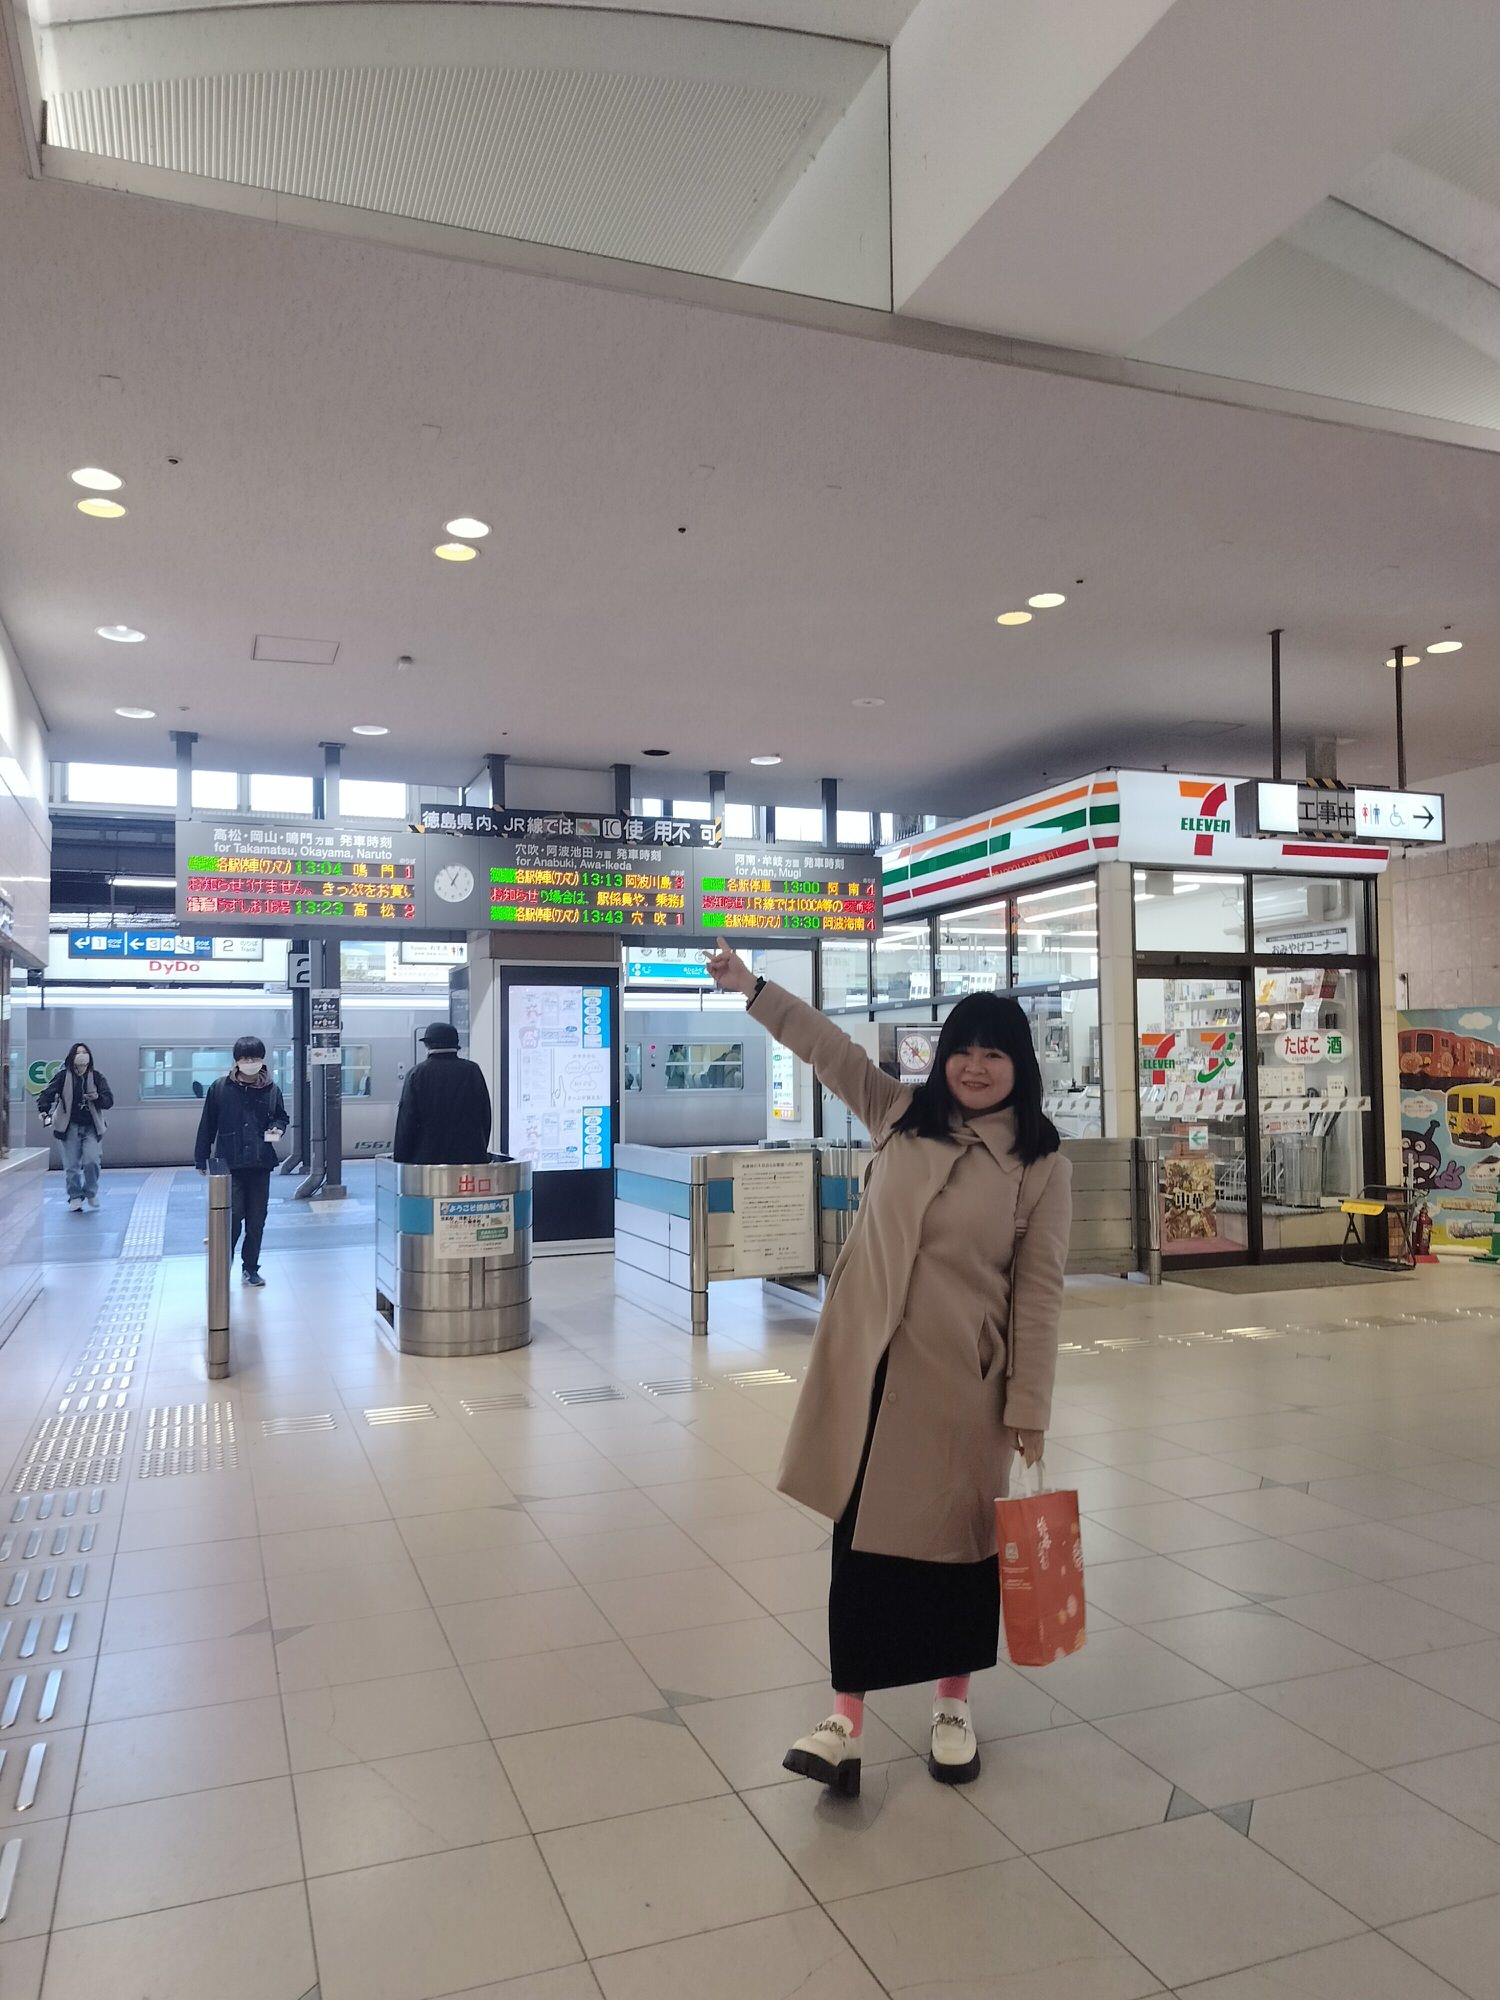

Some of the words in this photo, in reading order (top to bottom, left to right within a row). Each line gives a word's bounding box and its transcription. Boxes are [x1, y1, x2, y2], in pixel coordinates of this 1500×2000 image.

[1298, 799, 1356, 826] 工事中
[340, 834, 392, 849] 発車時刻
[214, 842, 232, 853] for
[233, 843, 298, 857] Takamatsu,
[300, 848, 354, 860] Okayama,
[356, 849, 392, 860] Naruto
[616, 848, 662, 862] 発車時刻
[295, 860, 343, 876] 13:04
[405, 865, 413, 879] 1
[516, 856, 532, 867] for
[533, 857, 578, 871] Anabuki,
[579, 860, 632, 871] Awa-Ikeda
[804, 856, 845, 870] 発車時刻
[735, 867, 749, 876] for
[750, 868, 777, 878] Anan,
[778, 869, 802, 879] Mugi
[582, 873, 623, 888] 13:13
[625, 874, 672, 890] 阿波川島
[727, 878, 772, 893] 各駅停車
[783, 881, 820, 895] 13:00
[866, 884, 876, 896] 4
[490, 888, 539, 904] お知らせ
[702, 895, 745, 911] お知らせ
[295, 901, 344, 916] 13:23
[404, 904, 415, 919] 2
[582, 911, 623, 925] 13:43
[675, 913, 683, 926] 1
[783, 916, 821, 930] 13:30
[866, 918, 876, 931] 4
[222, 939, 234, 952] 2
[1272, 938, 1341, 954] おみやげコーナー
[149, 960, 201, 974] DyDo
[1284, 1035, 1321, 1055] たばこ
[1326, 1035, 1343, 1055] 酒
[354, 1141, 392, 1150] 1561
[458, 1174, 491, 1193] 出口
[1174, 1188, 1206, 1211] 中華
